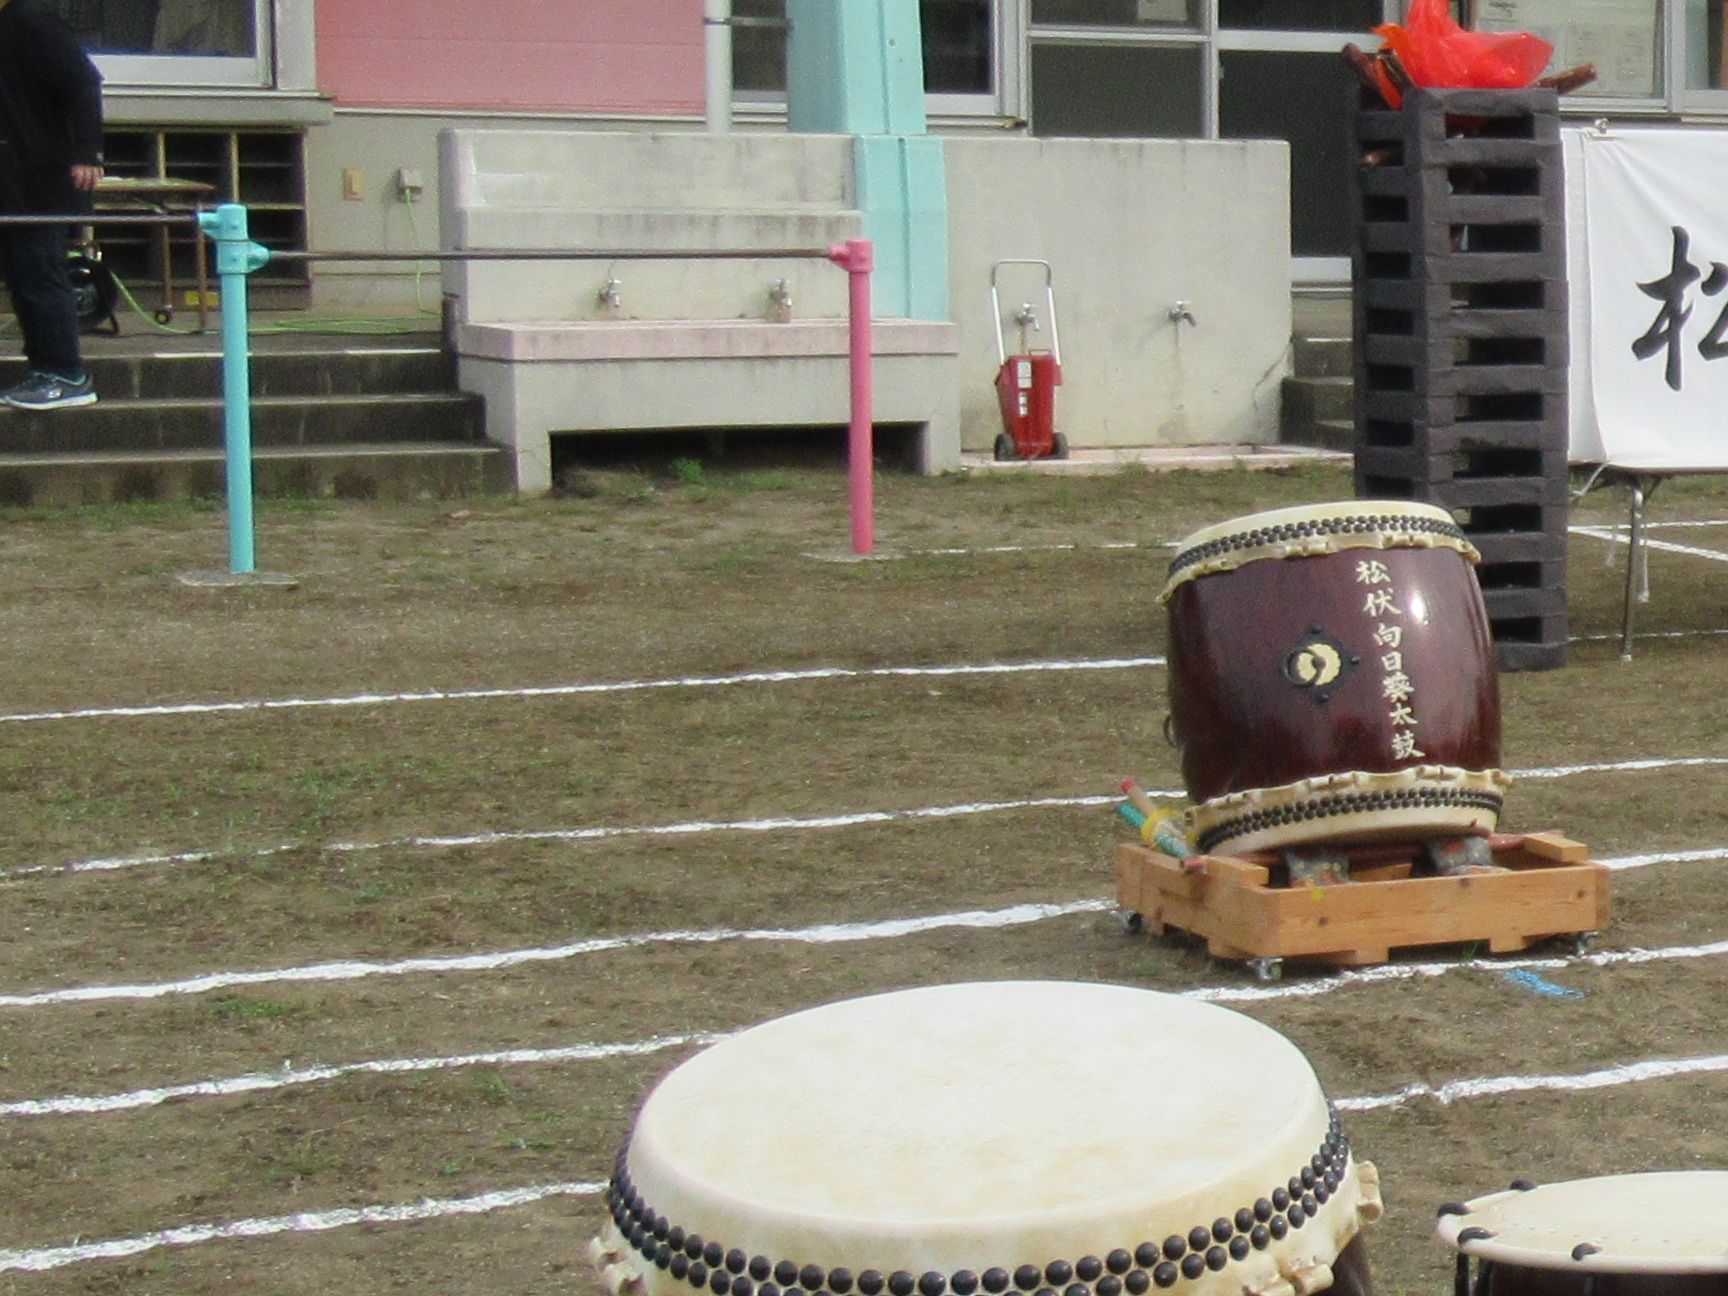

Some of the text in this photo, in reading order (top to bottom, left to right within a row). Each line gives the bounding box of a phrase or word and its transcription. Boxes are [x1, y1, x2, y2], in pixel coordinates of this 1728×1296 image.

[1355, 559, 1426, 761] 松伏向日葵太鼓
